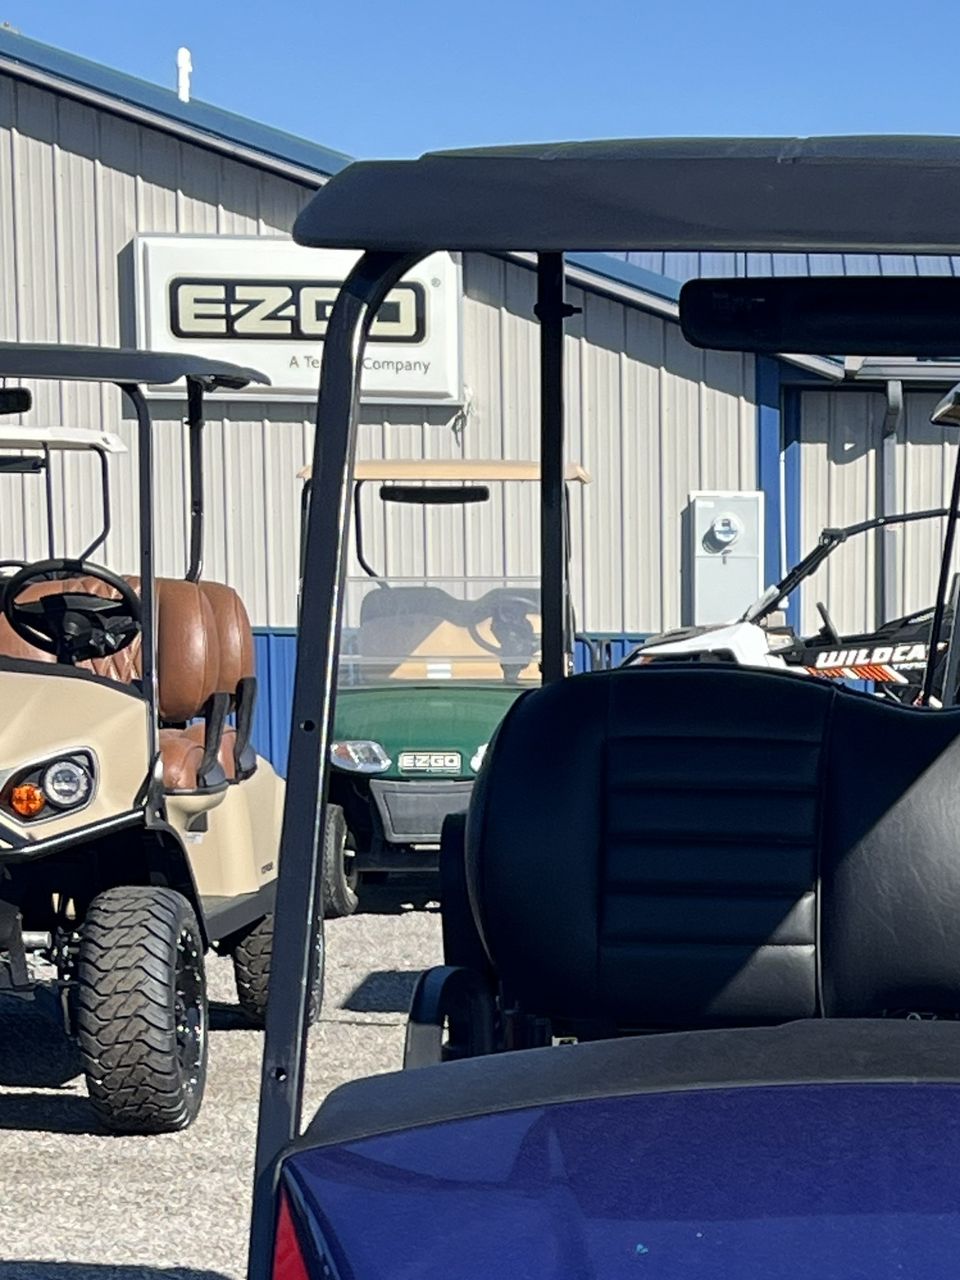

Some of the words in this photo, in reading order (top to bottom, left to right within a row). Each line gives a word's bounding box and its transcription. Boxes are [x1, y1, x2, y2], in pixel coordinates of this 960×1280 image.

[289, 355, 299, 369] A
[363, 357, 431, 375] Company
[402, 755, 459, 767] EZGO
